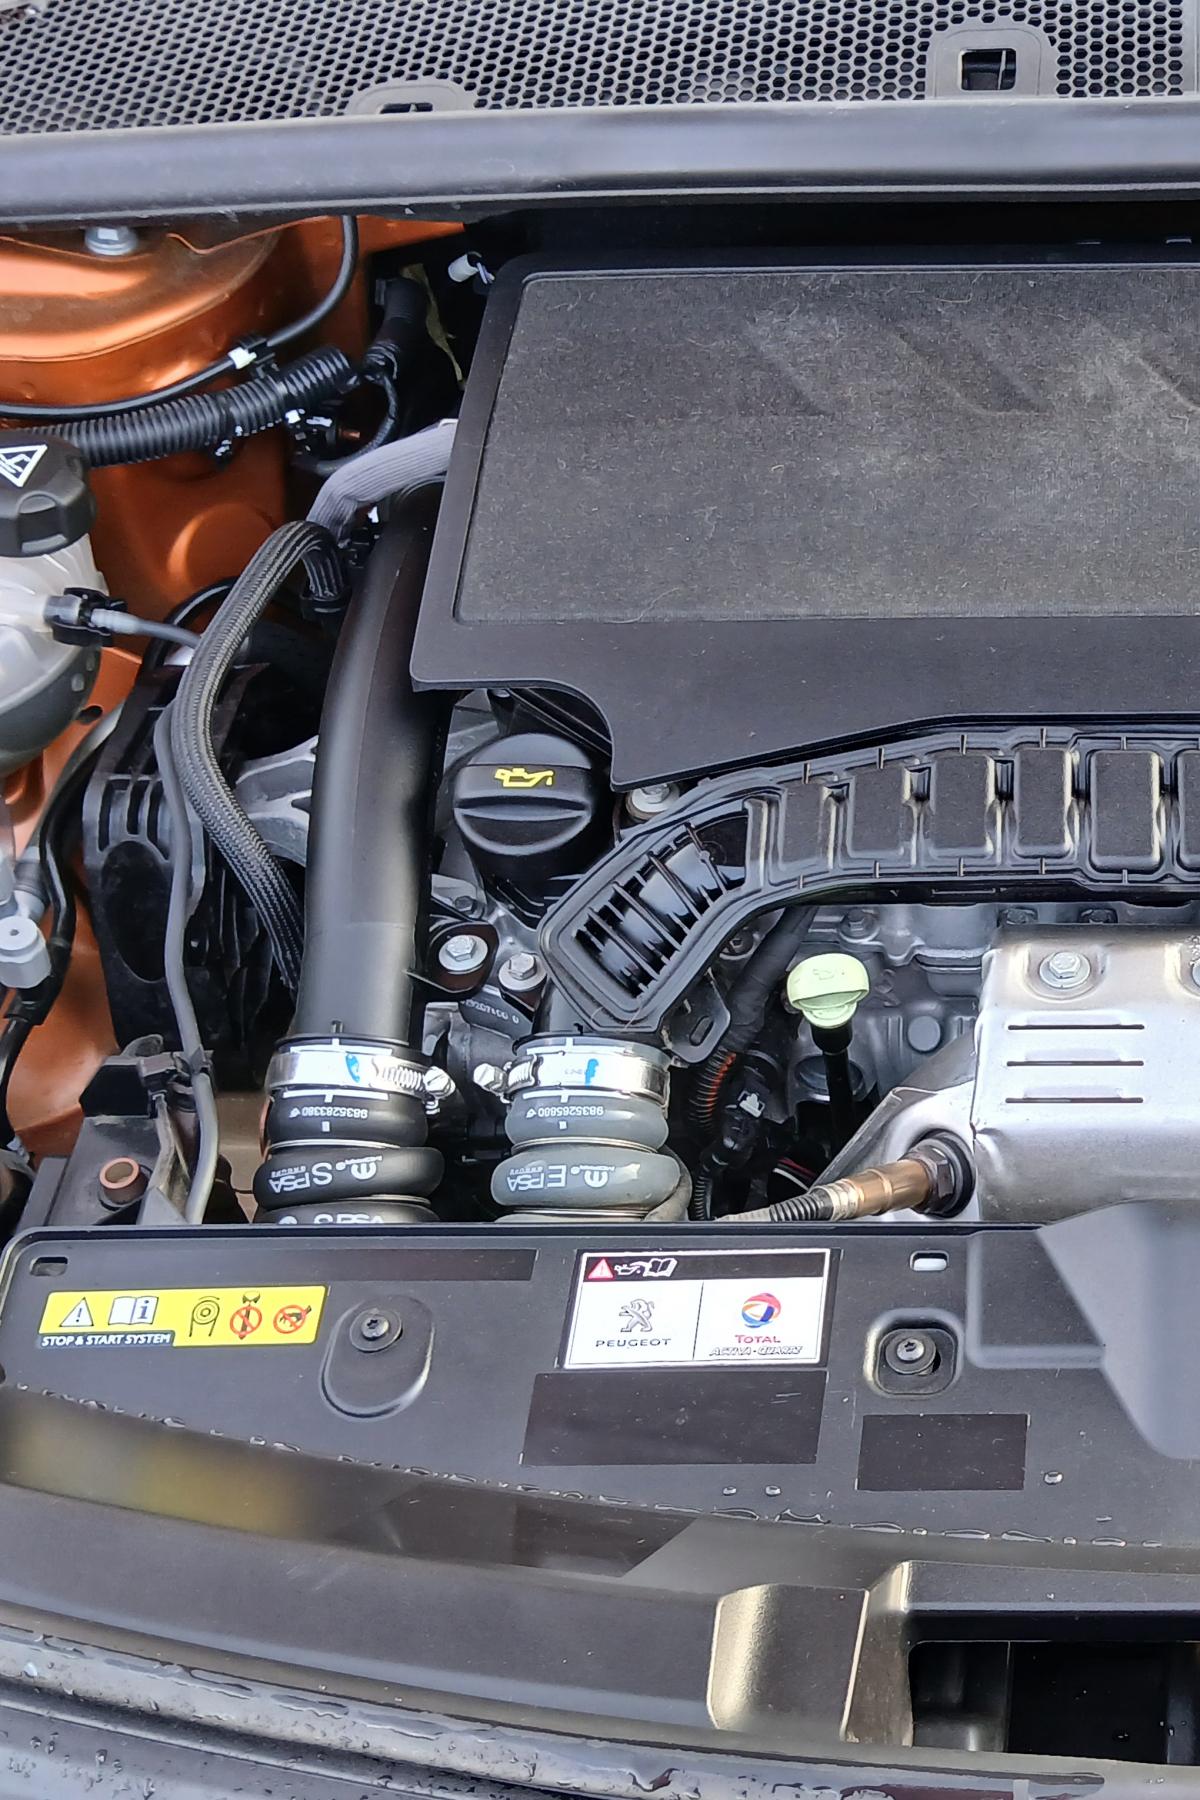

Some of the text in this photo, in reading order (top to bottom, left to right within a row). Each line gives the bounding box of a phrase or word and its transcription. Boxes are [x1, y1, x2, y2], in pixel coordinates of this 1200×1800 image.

[269, 1171, 311, 1193] PSA
[507, 1172, 545, 1192] PSA
[41, 1332, 171, 1347] STOP & START SYSTEM
[595, 1337, 672, 1348] PEUGEOT
[735, 1334, 781, 1344] TOTAL
